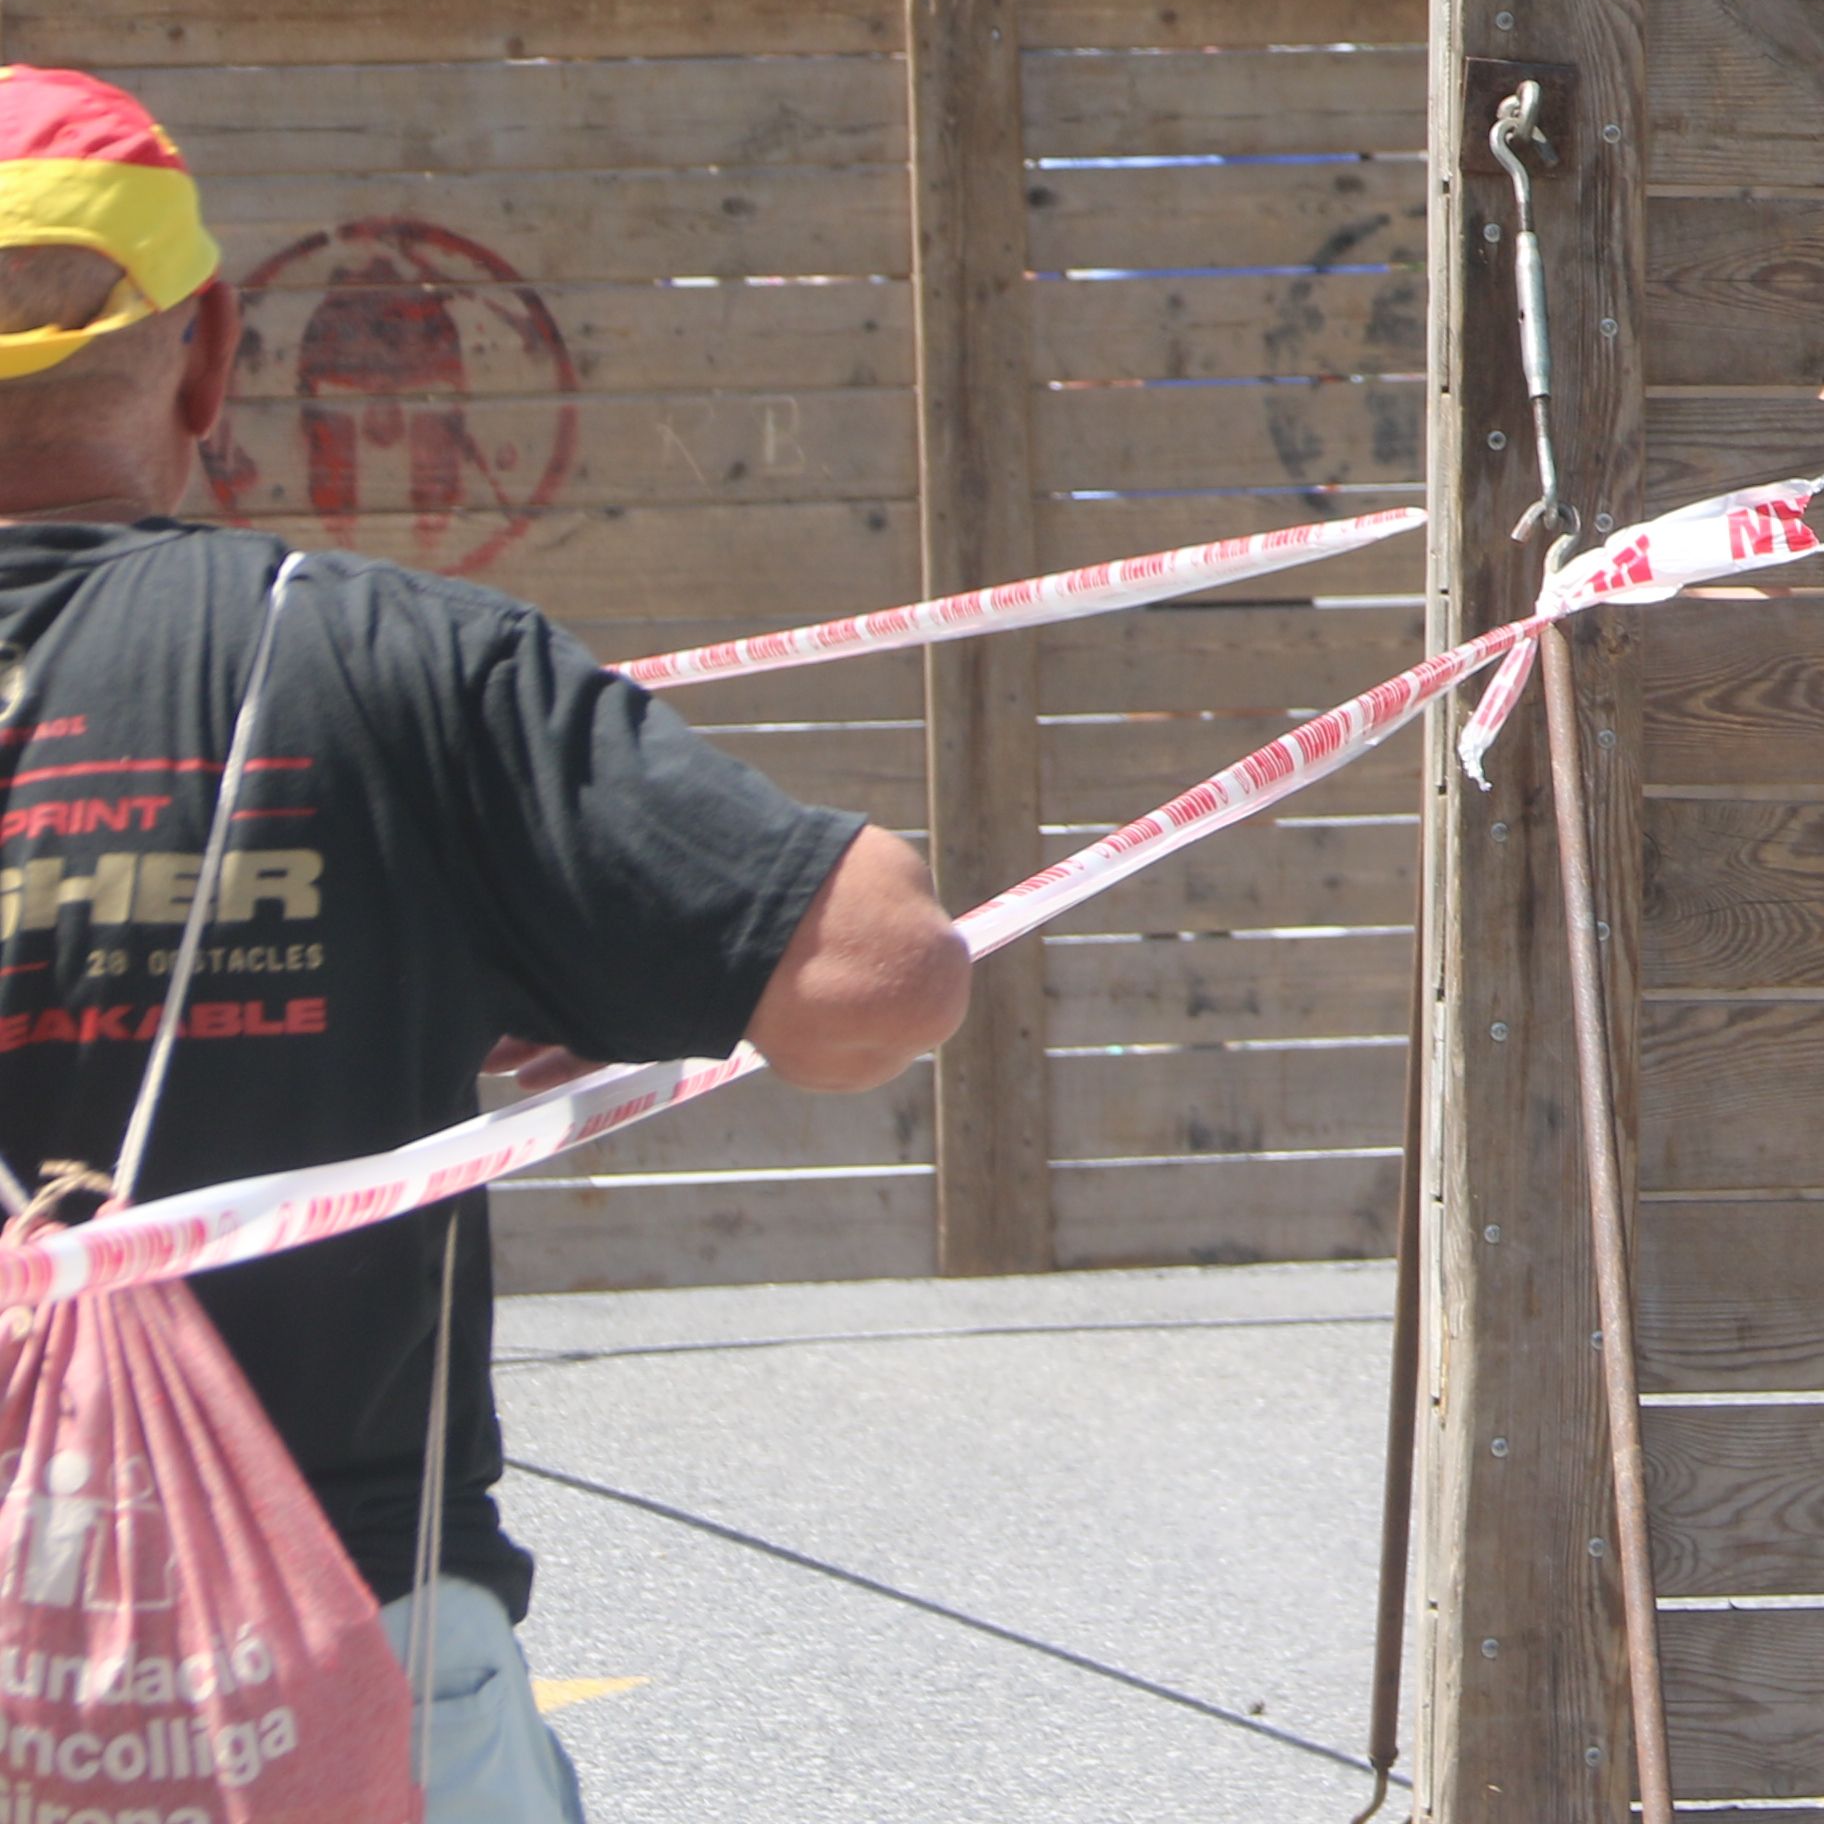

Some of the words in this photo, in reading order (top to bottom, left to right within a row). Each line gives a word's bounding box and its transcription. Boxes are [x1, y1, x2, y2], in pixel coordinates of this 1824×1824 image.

[0, 848, 324, 941] HER
[0, 1706, 297, 1787] ncolliga
[0, 1778, 212, 1824] irona
